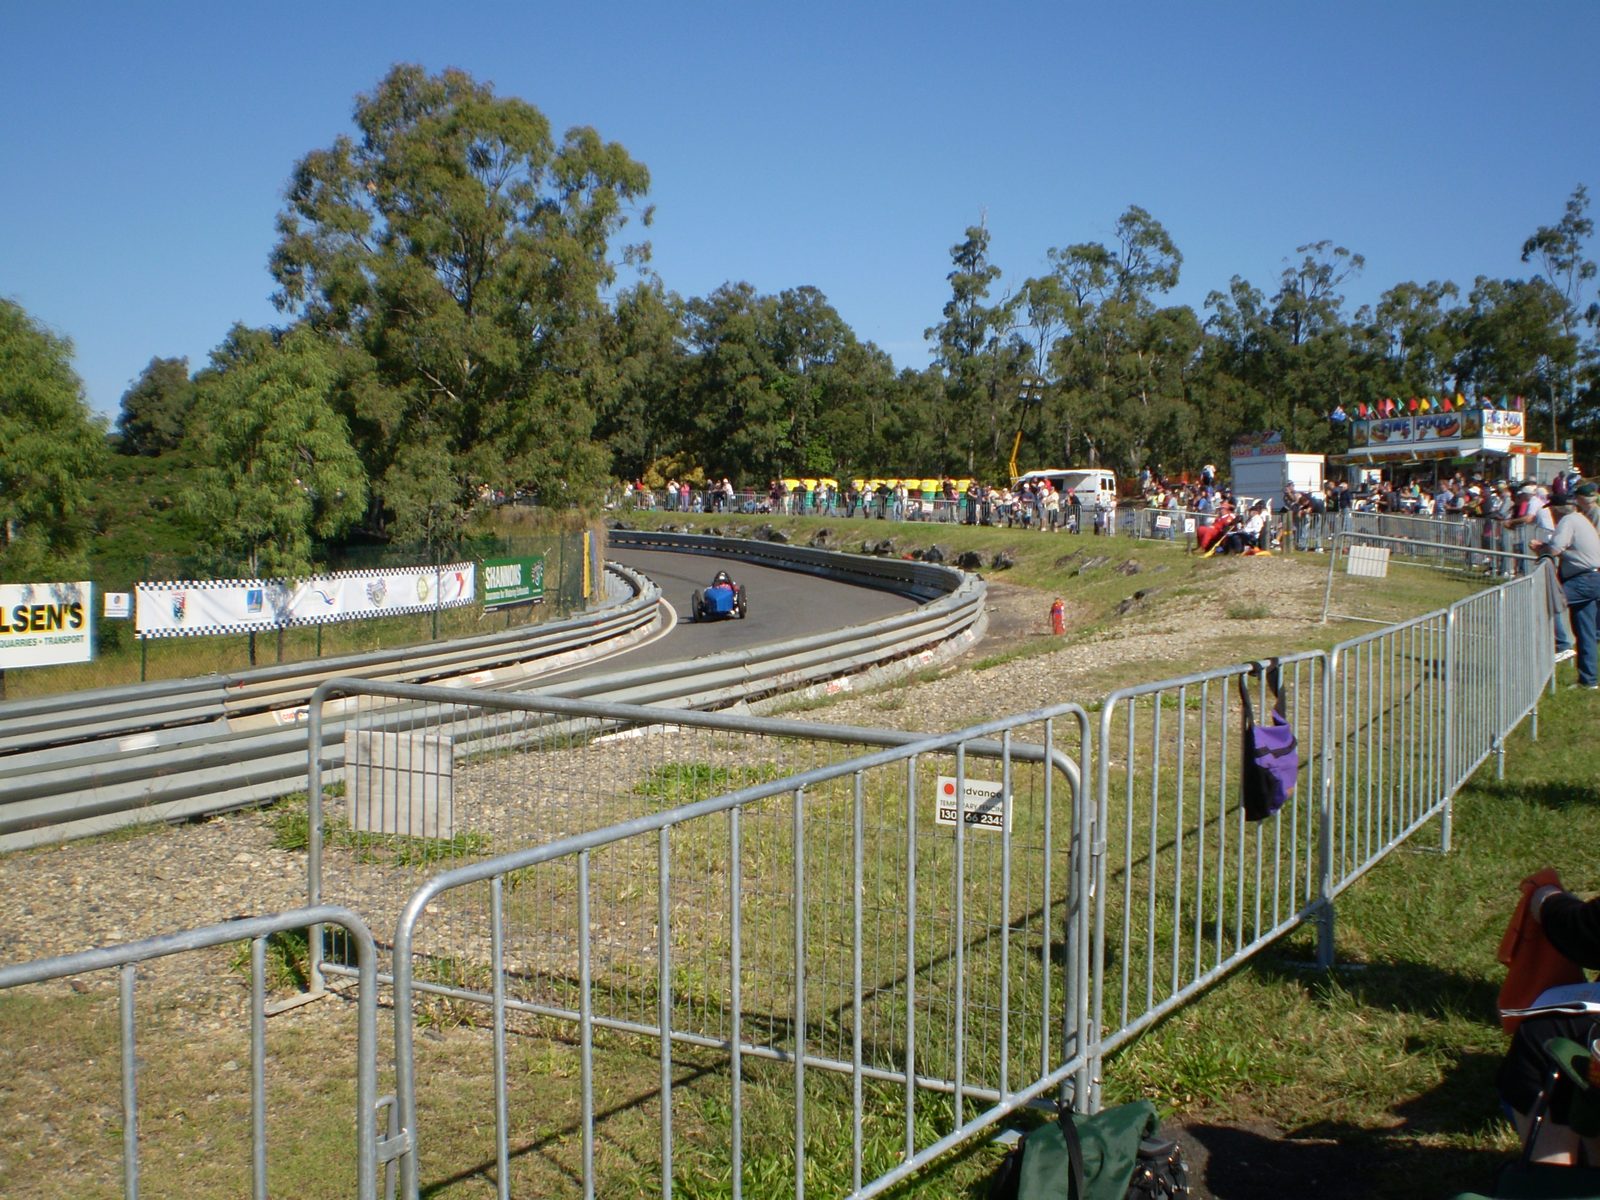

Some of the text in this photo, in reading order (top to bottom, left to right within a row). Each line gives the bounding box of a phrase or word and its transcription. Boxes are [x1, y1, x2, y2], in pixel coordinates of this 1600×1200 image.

[1416, 414, 1453, 430] FOOD
[1186, 521, 1194, 531] 2
[44, 635, 84, 645] TRANSPORT
[963, 787, 1002, 798] dvance
[940, 799, 1003, 813] TEMPARY FENCIN
[941, 809, 957, 820] 130
[965, 813, 979, 822] 66
